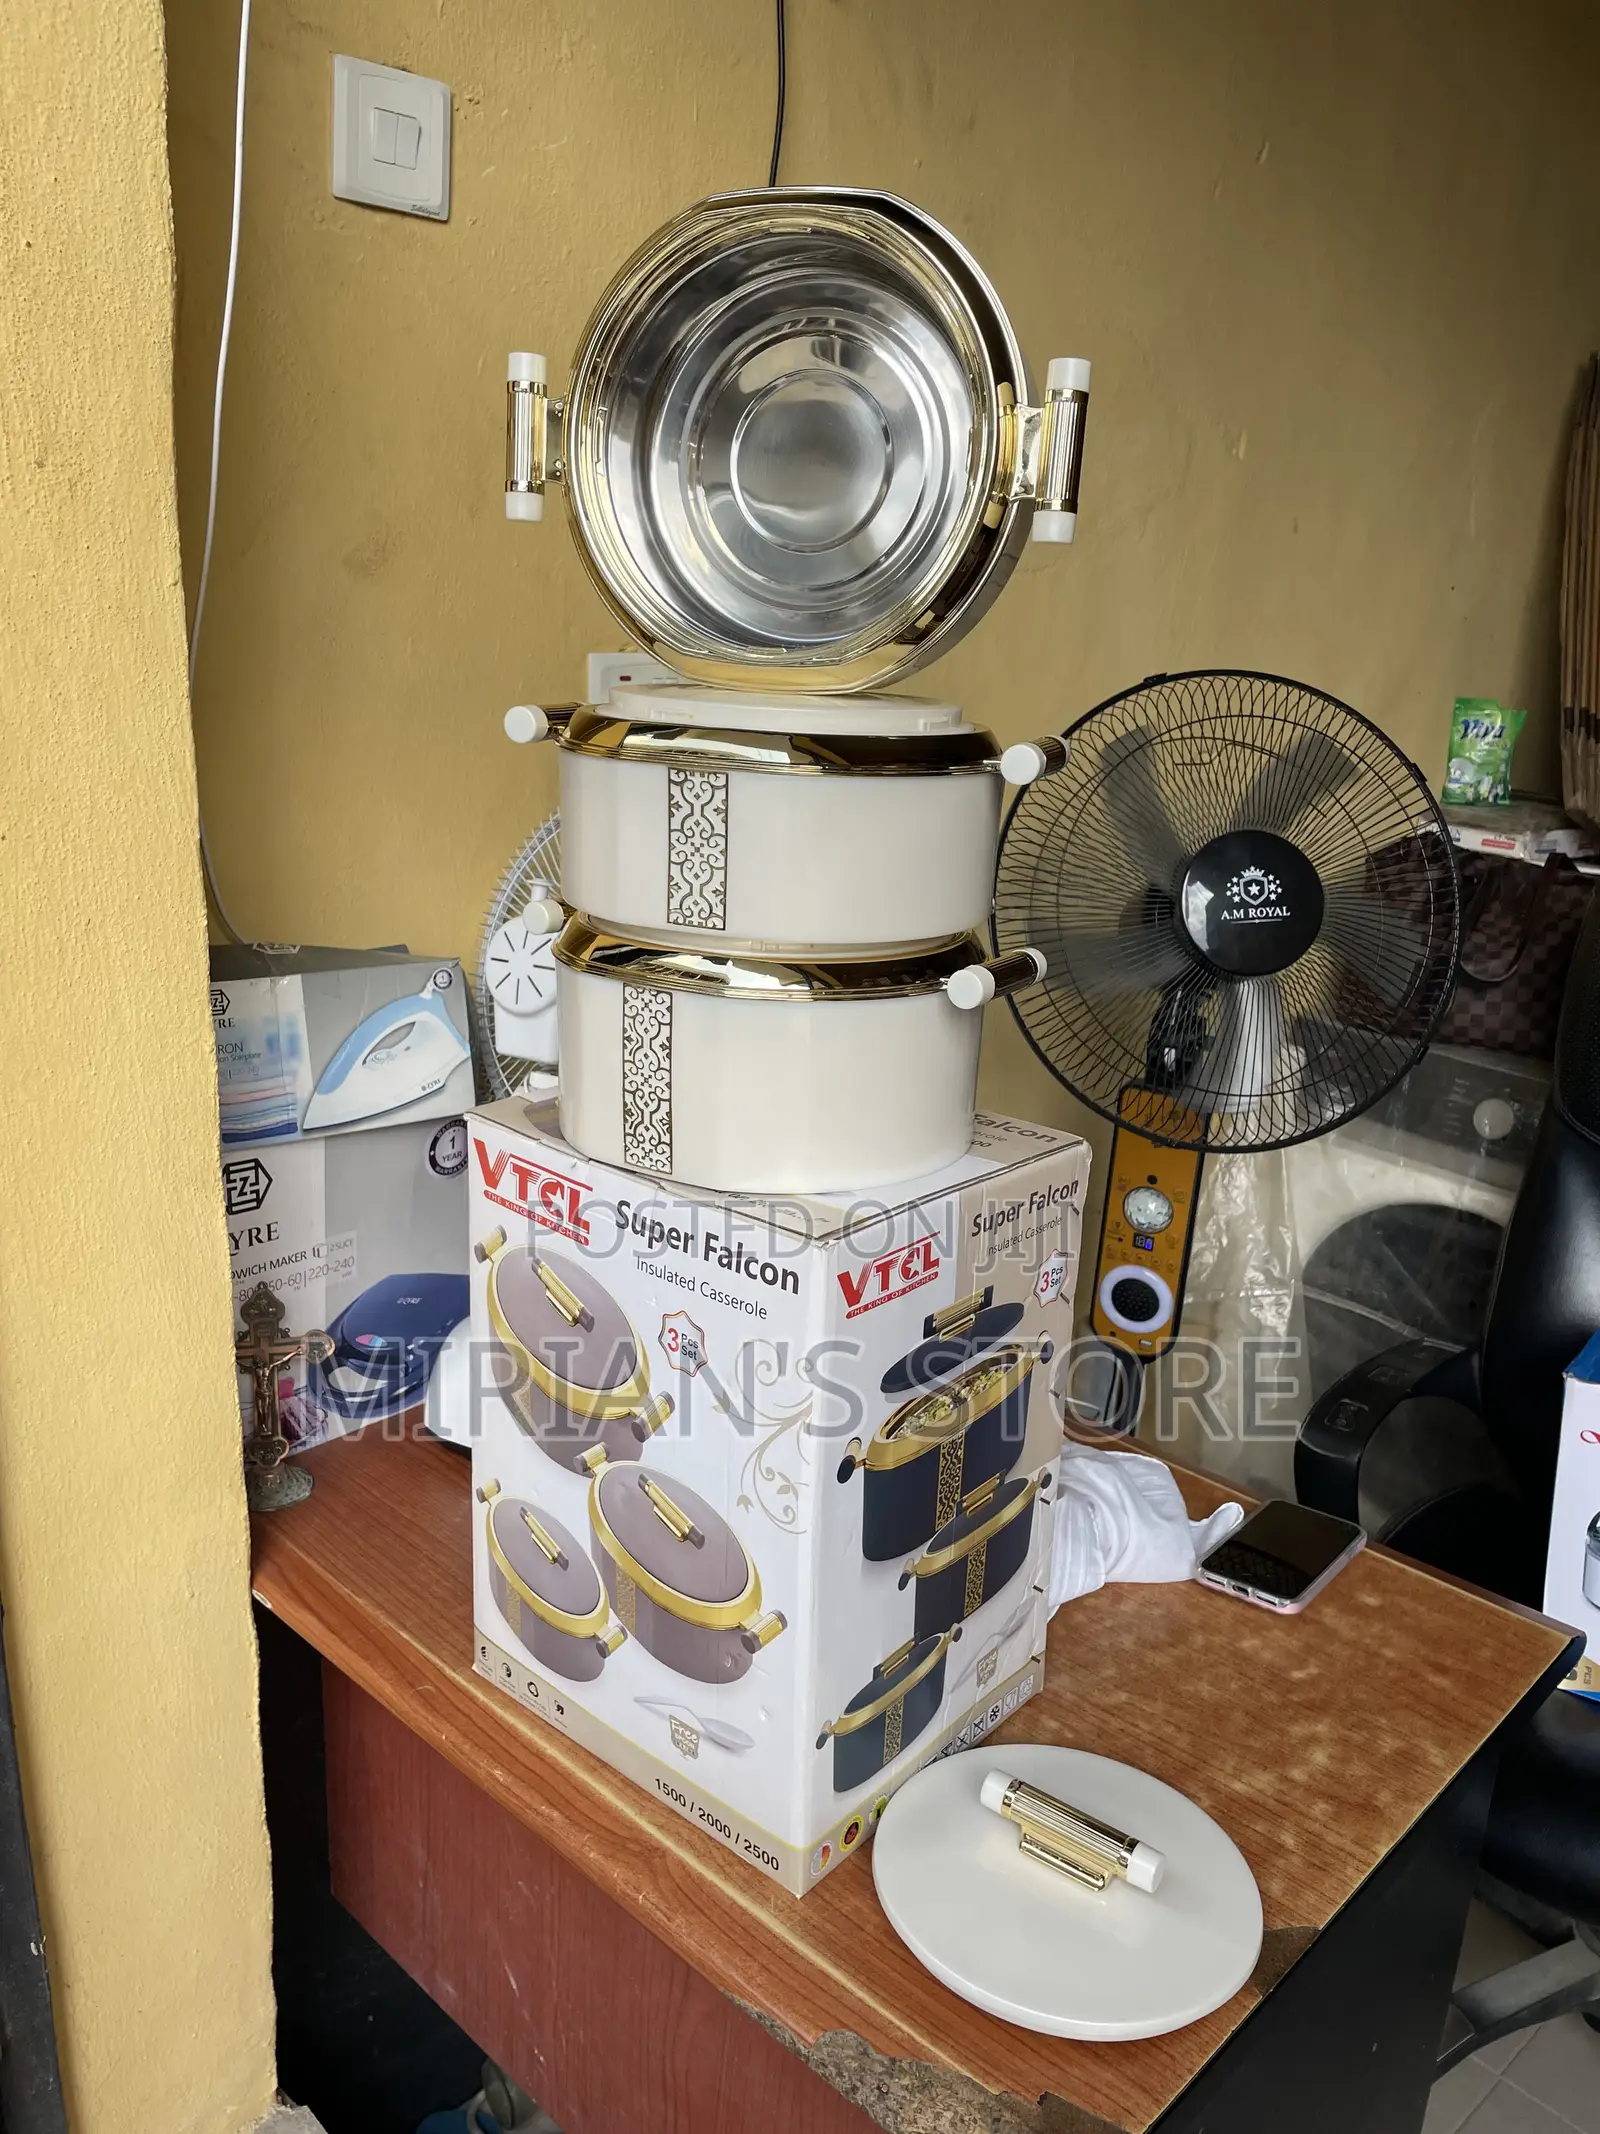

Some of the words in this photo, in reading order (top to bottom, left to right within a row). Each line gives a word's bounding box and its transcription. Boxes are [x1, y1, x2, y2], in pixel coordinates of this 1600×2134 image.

[1221, 909, 1244, 920] A.M
[1248, 906, 1291, 918] ROYAL
[214, 1017, 236, 1029] RE
[217, 1042, 243, 1054] RON
[973, 1130, 1007, 1142] erole
[974, 1113, 1058, 1143] Falcon
[450, 1136, 455, 1149] 1
[972, 1140, 991, 1148] 00
[442, 1151, 463, 1162] YEAR
[473, 1137, 593, 1234] VTCL
[487, 1192, 501, 1204] THE
[505, 1202, 528, 1217] KING
[531, 1213, 543, 1223] OF
[546, 1220, 585, 1243] KITCHEN
[972, 1202, 1024, 1238] Super
[1029, 1179, 1079, 1216] Falcon
[229, 1221, 280, 1256] YRE
[1025, 1216, 1063, 1240] Casserole
[616, 1200, 694, 1253] Super
[704, 1232, 800, 1295] Falcon
[231, 1263, 267, 1280] DWICH
[270, 1250, 307, 1270] MAKER
[837, 1231, 940, 1308] VTCL
[637, 1256, 696, 1292] Insulated
[700, 1281, 768, 1320] Casserole
[1040, 1271, 1050, 1293] 3
[1051, 1266, 1064, 1277] Pcs
[1050, 1276, 1062, 1288] Set
[850, 1306, 864, 1317] THE
[869, 1297, 888, 1310] KING
[891, 1290, 902, 1299] OF
[906, 1274, 936, 1292] KITCHEN
[667, 1327, 680, 1353] 3
[681, 1333, 699, 1349] Pcs
[681, 1345, 697, 1360] Set
[671, 1719, 698, 1743] Free
[655, 1778, 686, 1808] 1500
[690, 1802, 694, 1812] /
[698, 1807, 731, 1839] 2000
[735, 1833, 740, 1844] /
[744, 1838, 779, 1871] 2500
